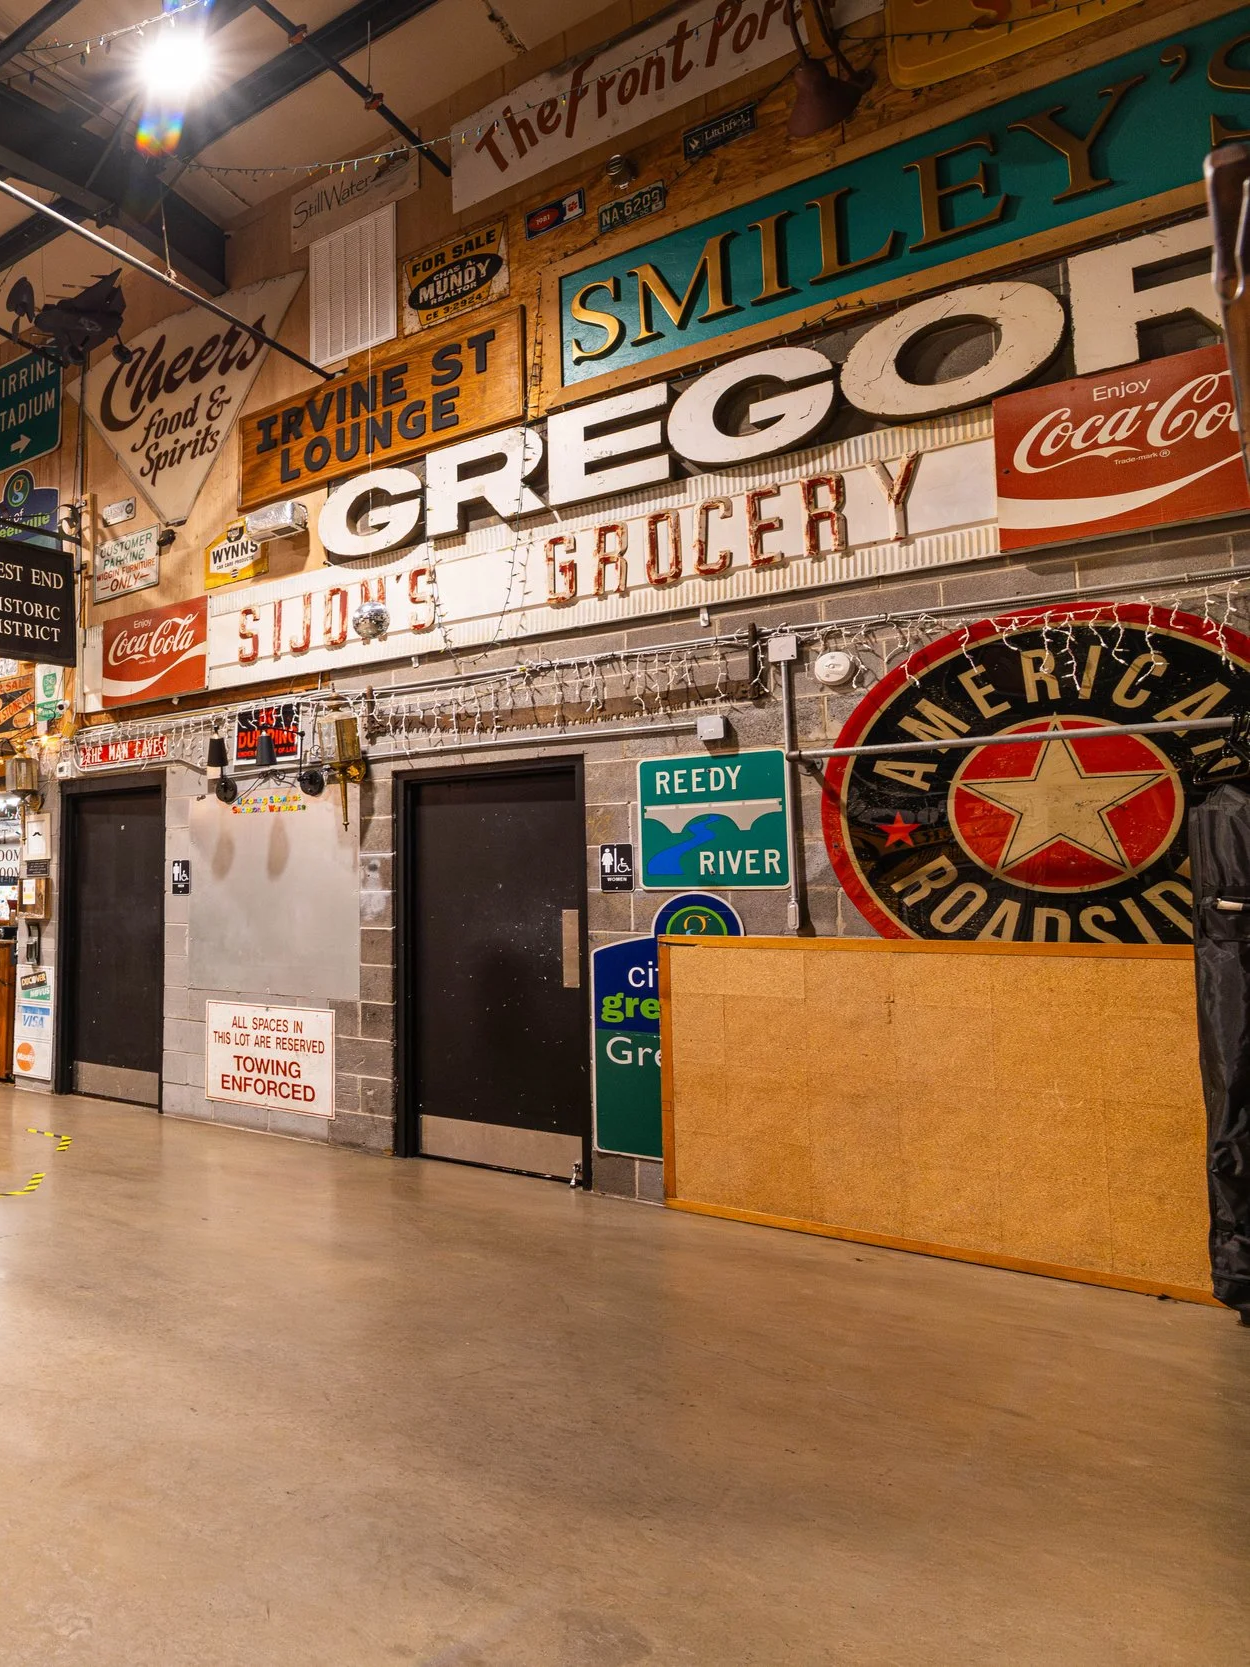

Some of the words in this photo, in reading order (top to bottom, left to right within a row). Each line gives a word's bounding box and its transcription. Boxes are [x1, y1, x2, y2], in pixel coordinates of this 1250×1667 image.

[474, 98, 562, 172] The
[565, 20, 695, 138] Front
[412, 252, 446, 277] FOR
[452, 230, 496, 259] SALE
[419, 259, 491, 303] MUNDY
[433, 264, 460, 281] CHAS
[430, 281, 477, 305] REALTOR
[426, 311, 439, 321] CE
[99, 314, 266, 432] Cheers
[256, 364, 408, 455] IRVINE
[431, 329, 496, 387] ST
[1092, 377, 1152, 402] Enjoy
[132, 404, 206, 453] food
[206, 385, 232, 421] &
[281, 386, 460, 484] LOUNGE
[140, 425, 219, 487] Spirits
[544, 449, 920, 604] GROCERY
[100, 532, 153, 559] CUSTOMER
[103, 548, 146, 569] PARKING
[32, 566, 64, 590] END
[122, 557, 156, 573] FURNITURE
[110, 572, 141, 592] ONLY
[133, 618, 152, 630] Enjoy
[108, 611, 200, 667] Coca-Cola
[108, 742, 129, 760] MAN
[134, 737, 160, 758] CAVE
[656, 764, 742, 796] REEDY
[699, 848, 782, 876] RIVER
[23, 1014, 45, 1029] VISA
[231, 1016, 248, 1030] ALL
[252, 1017, 289, 1033] SPACES
[293, 1020, 303, 1034] IN
[213, 1031, 231, 1045] THIS
[234, 1032, 251, 1046] LOT
[254, 1034, 273, 1049] ARE
[275, 1035, 325, 1054] RESERVED
[233, 1054, 301, 1079] TOWING
[220, 1074, 317, 1103] ENFORCED
